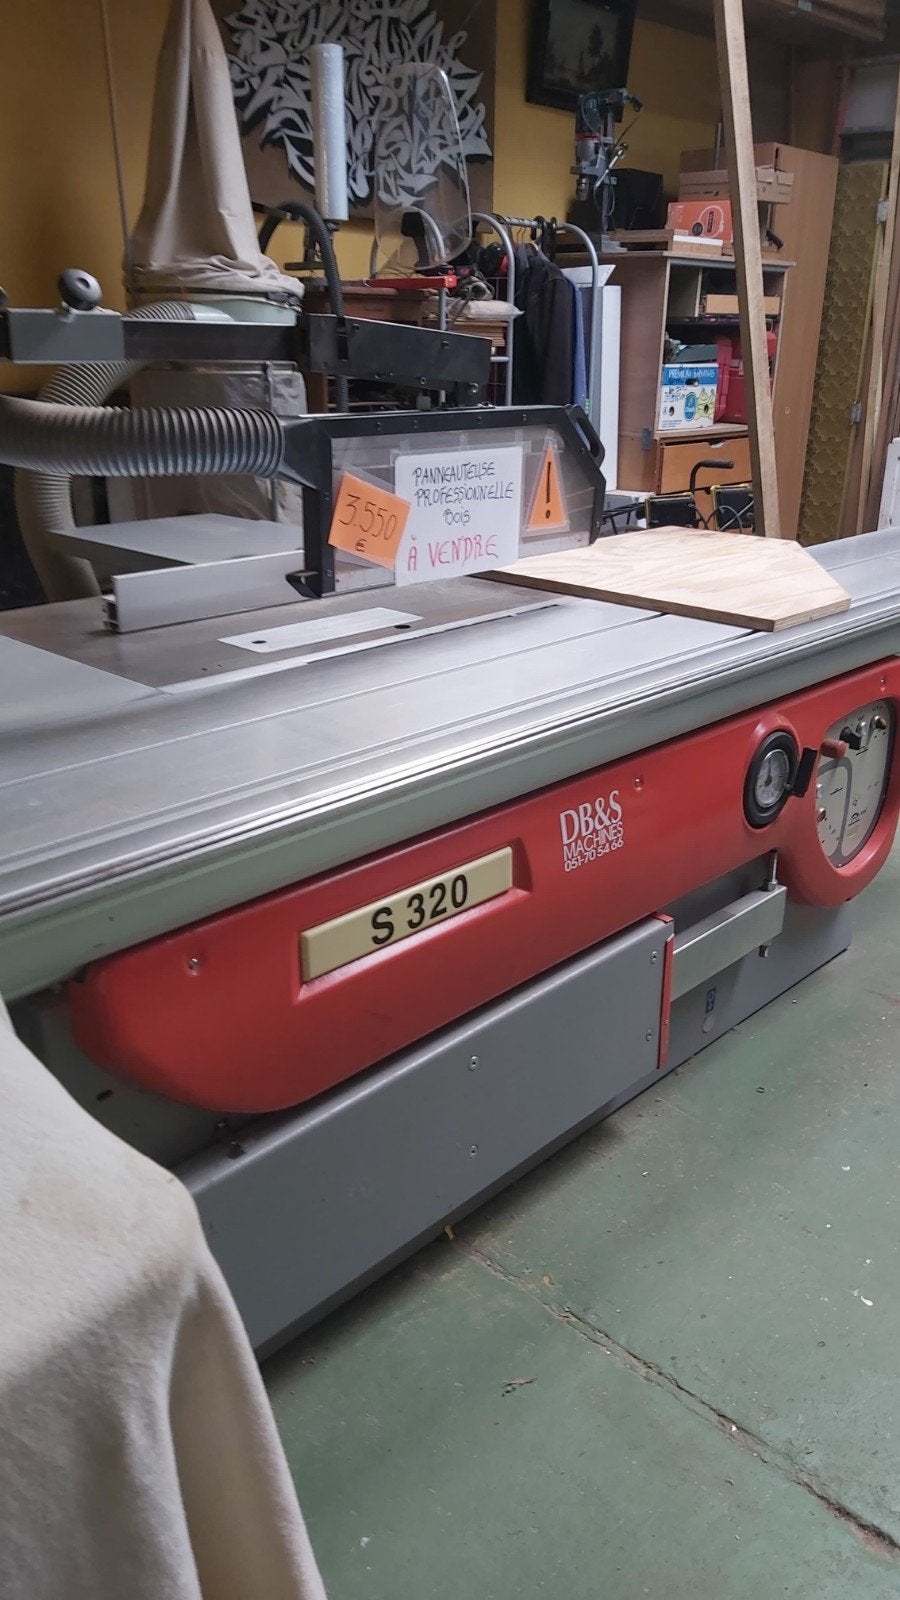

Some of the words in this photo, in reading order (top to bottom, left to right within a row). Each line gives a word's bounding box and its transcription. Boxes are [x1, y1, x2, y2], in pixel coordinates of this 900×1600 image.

[668, 369, 692, 378] PREMIUM
[412, 462, 495, 486] PANNEAUTEUSE
[414, 482, 514, 507] PROFESSIONNELLE
[338, 493, 398, 541] 3.550
[354, 538, 367, 553] €
[407, 534, 417, 572] À
[428, 534, 499, 568] VENDRE
[560, 790, 622, 845] DB&S
[563, 821, 624, 862] MACHINES
[564, 849, 596, 872] 051-70
[597, 843, 610, 857] 54
[611, 837, 624, 850] 66
[371, 906, 394, 945] S
[407, 874, 468, 929] 320
